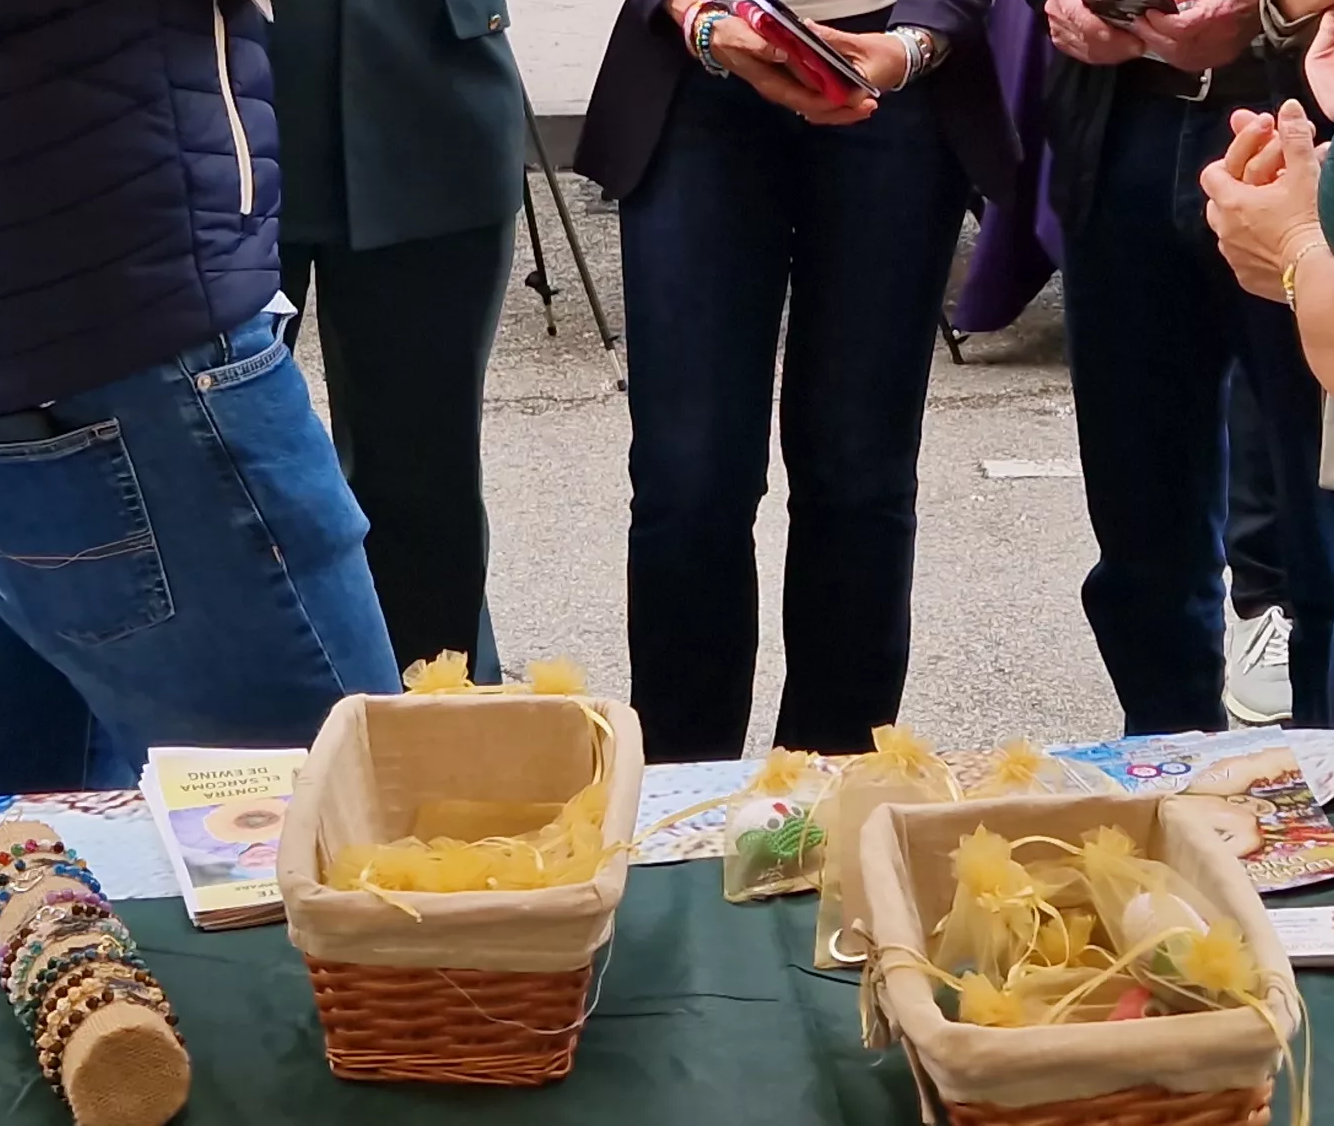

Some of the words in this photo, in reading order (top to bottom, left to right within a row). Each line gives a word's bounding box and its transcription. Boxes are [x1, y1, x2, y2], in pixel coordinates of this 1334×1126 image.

[187, 769, 243, 781] EWING
[247, 767, 267, 775] DE
[180, 777, 259, 792] SARCOMA
[261, 775, 281, 783] EL
[203, 786, 268, 799] CONTRA
